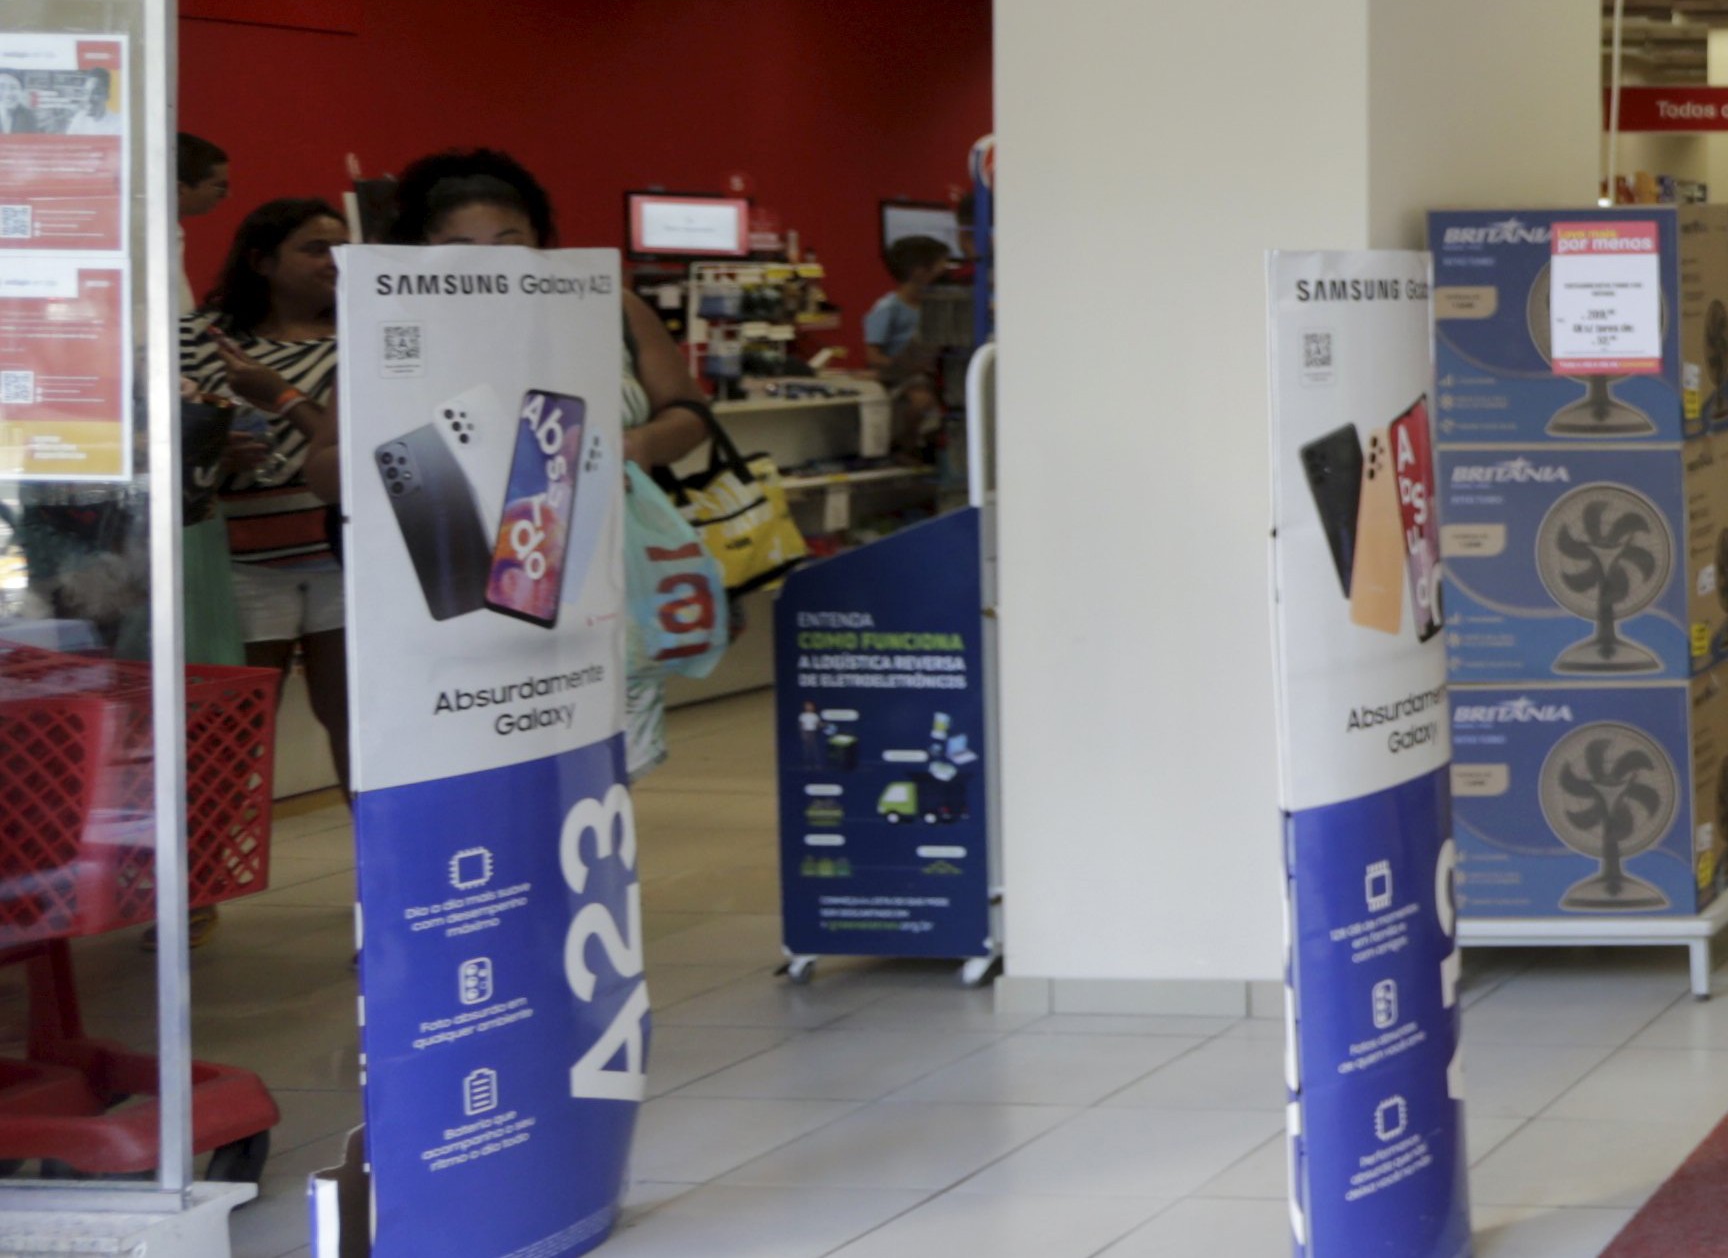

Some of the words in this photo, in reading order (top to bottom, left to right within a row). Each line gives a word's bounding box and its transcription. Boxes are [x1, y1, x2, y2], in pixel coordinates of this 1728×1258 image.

[1656, 100, 1715, 119] Todos
[1558, 237, 1588, 253] por
[1591, 237, 1653, 251] menos
[376, 273, 510, 296] SAMSUNG
[519, 274, 588, 299] Galaxy
[1296, 279, 1401, 302] SAMSUNG
[799, 632, 858, 650] COMO
[862, 632, 965, 652] FUNCIONA
[812, 651, 891, 671] LOGÍSTICA
[893, 655, 967, 672] REVERSA
[434, 663, 605, 716] Absurdamente
[494, 703, 577, 737] Galaxy
[1388, 721, 1437, 755] Galaxy
[411, 917, 445, 932] com
[446, 897, 529, 924] desempenho
[560, 782, 649, 1102] A23
[413, 1025, 476, 1050] qualquer
[477, 1008, 533, 1033] ambiente
[420, 1019, 452, 1034] Foto
[443, 1119, 494, 1141] Bateria
[422, 1127, 504, 1161] acompanha
